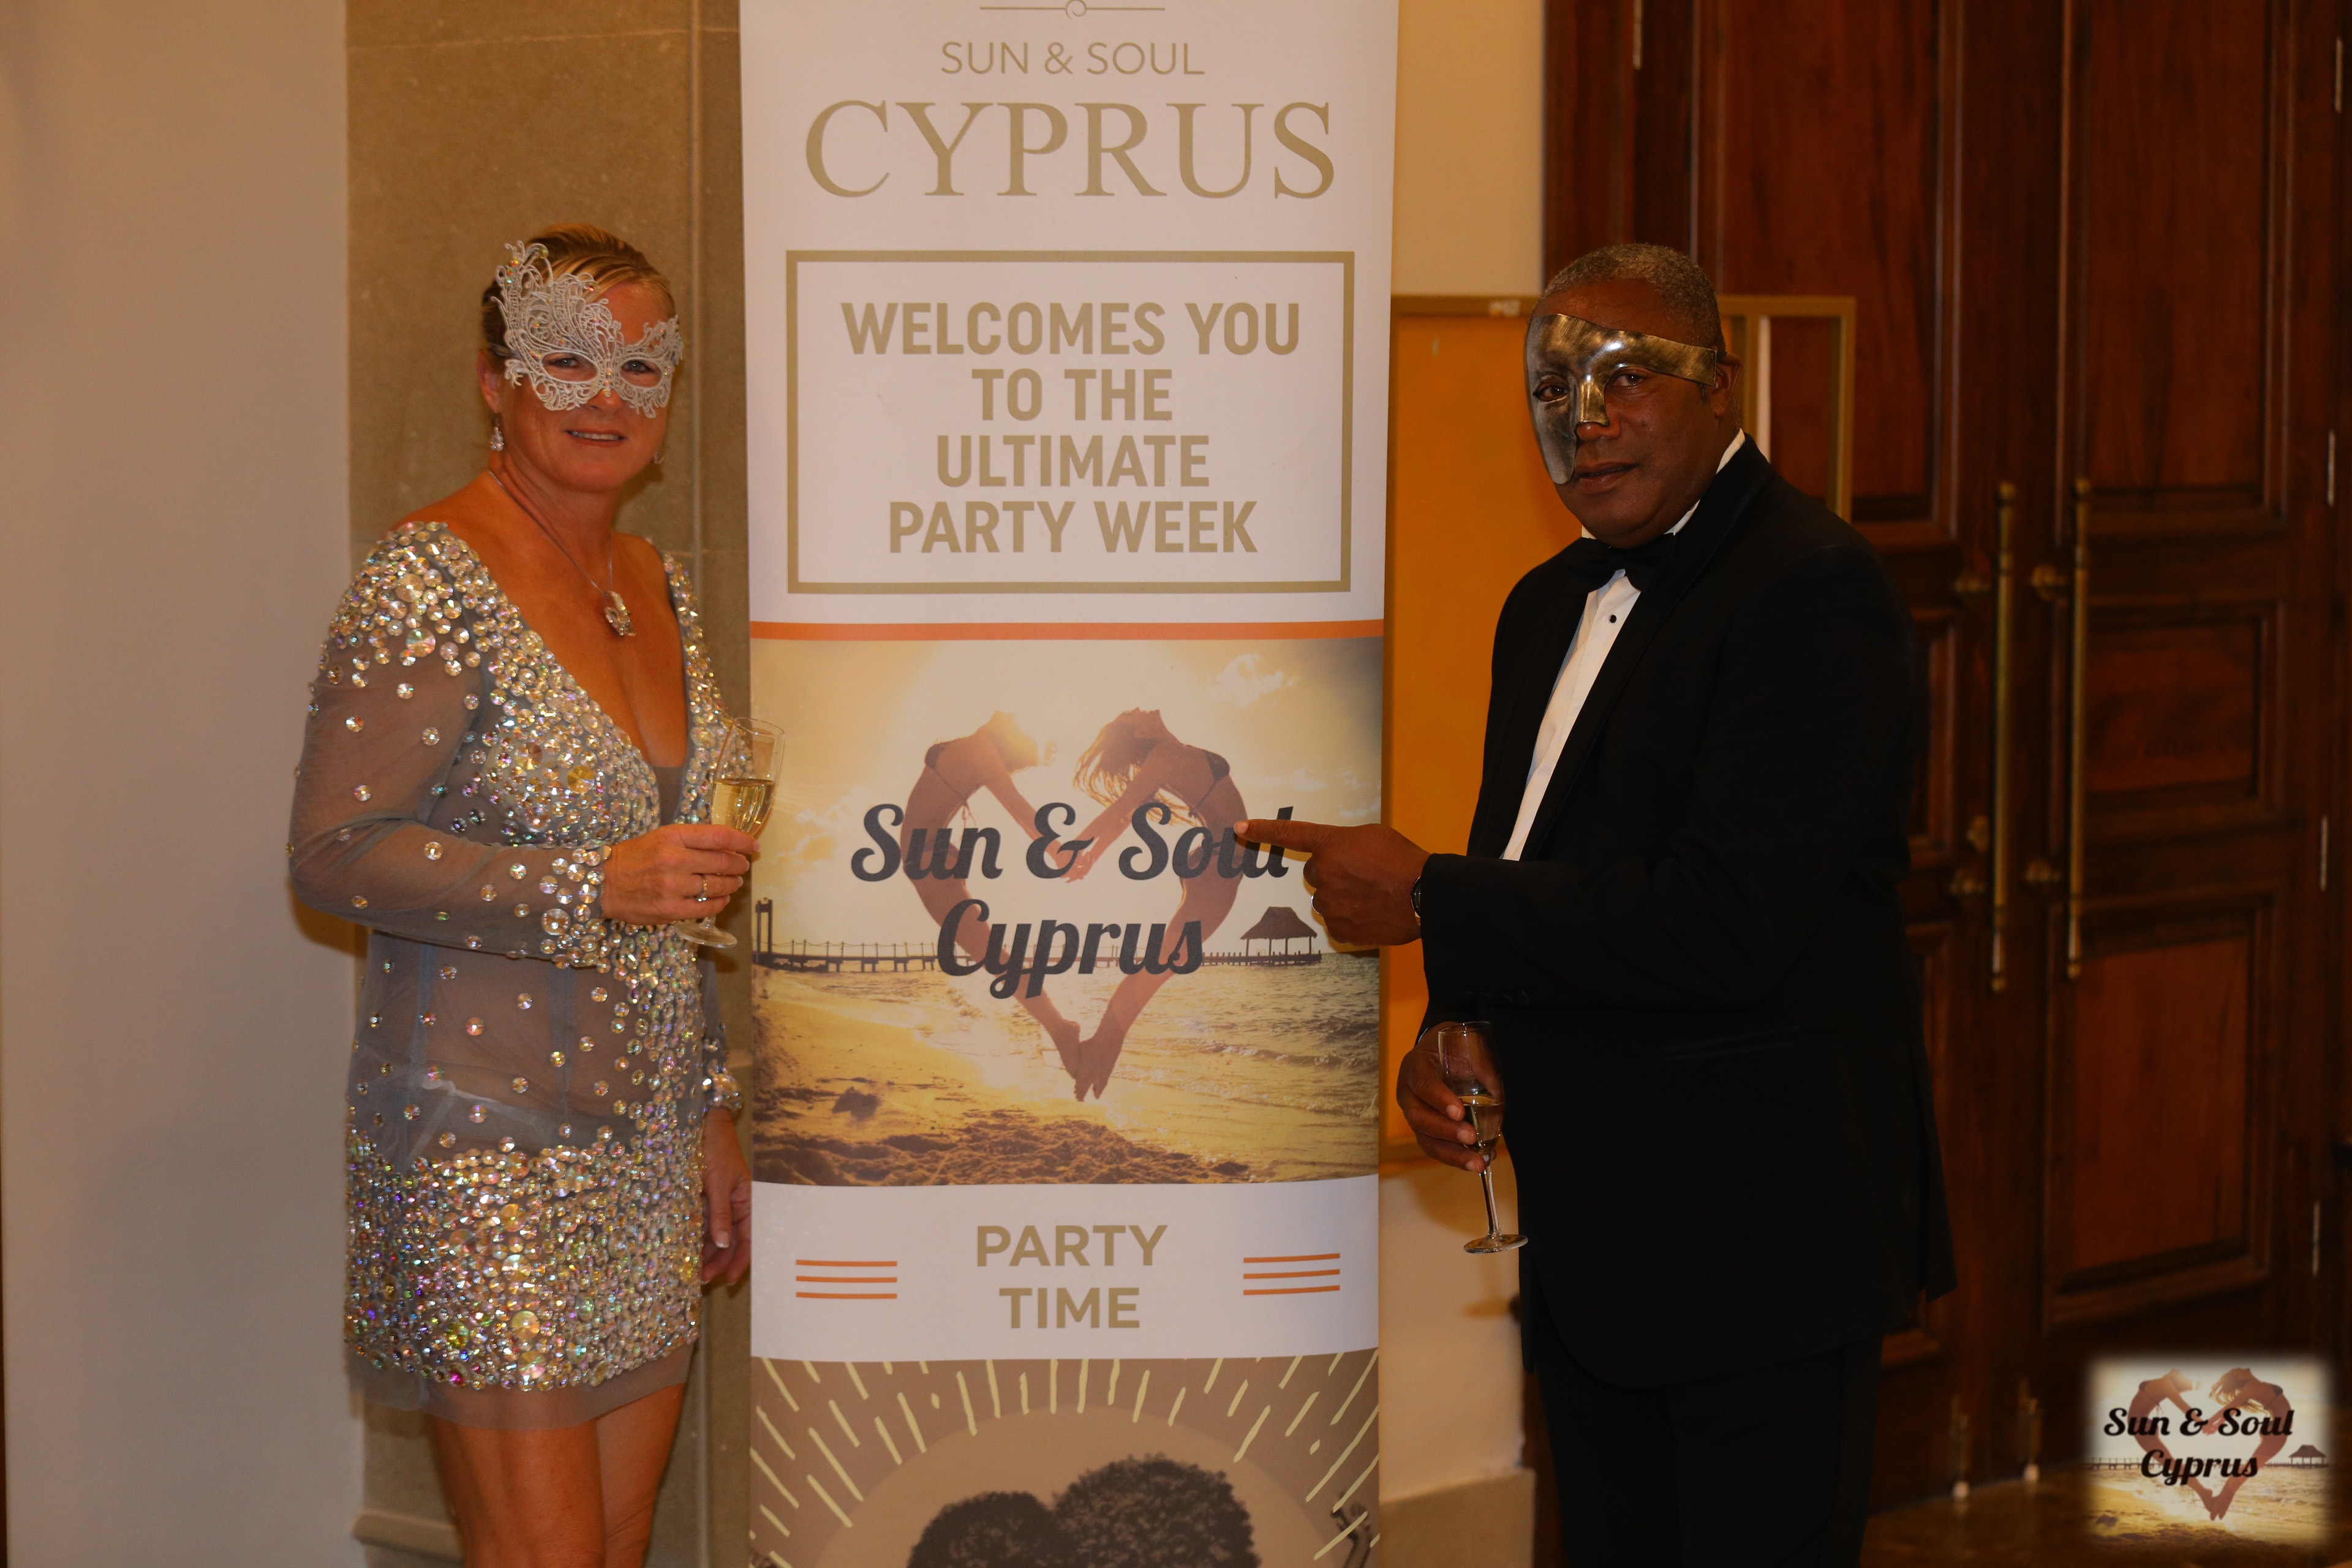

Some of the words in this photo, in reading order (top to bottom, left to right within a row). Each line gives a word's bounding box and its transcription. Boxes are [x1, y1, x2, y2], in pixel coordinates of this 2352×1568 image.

[942, 42, 1028, 74] SUN
[1045, 42, 1072, 74] &
[1087, 42, 1205, 74] SOUL
[805, 100, 1334, 198] CYPRUS
[841, 302, 1164, 355] WELCOMES
[1185, 302, 1299, 355] YOU
[971, 368, 1042, 421] TO
[1064, 369, 1172, 421] THE
[938, 435, 1209, 487] ULTIMATE
[890, 501, 1075, 553] PARTY
[1094, 501, 1257, 552] WEEK
[851, 803, 1003, 881] Sun
[1026, 802, 1094, 880] &
[937, 899, 1204, 999] Cyprus
[977, 1225, 1167, 1267] PARTY
[999, 1287, 1140, 1329] TIME
